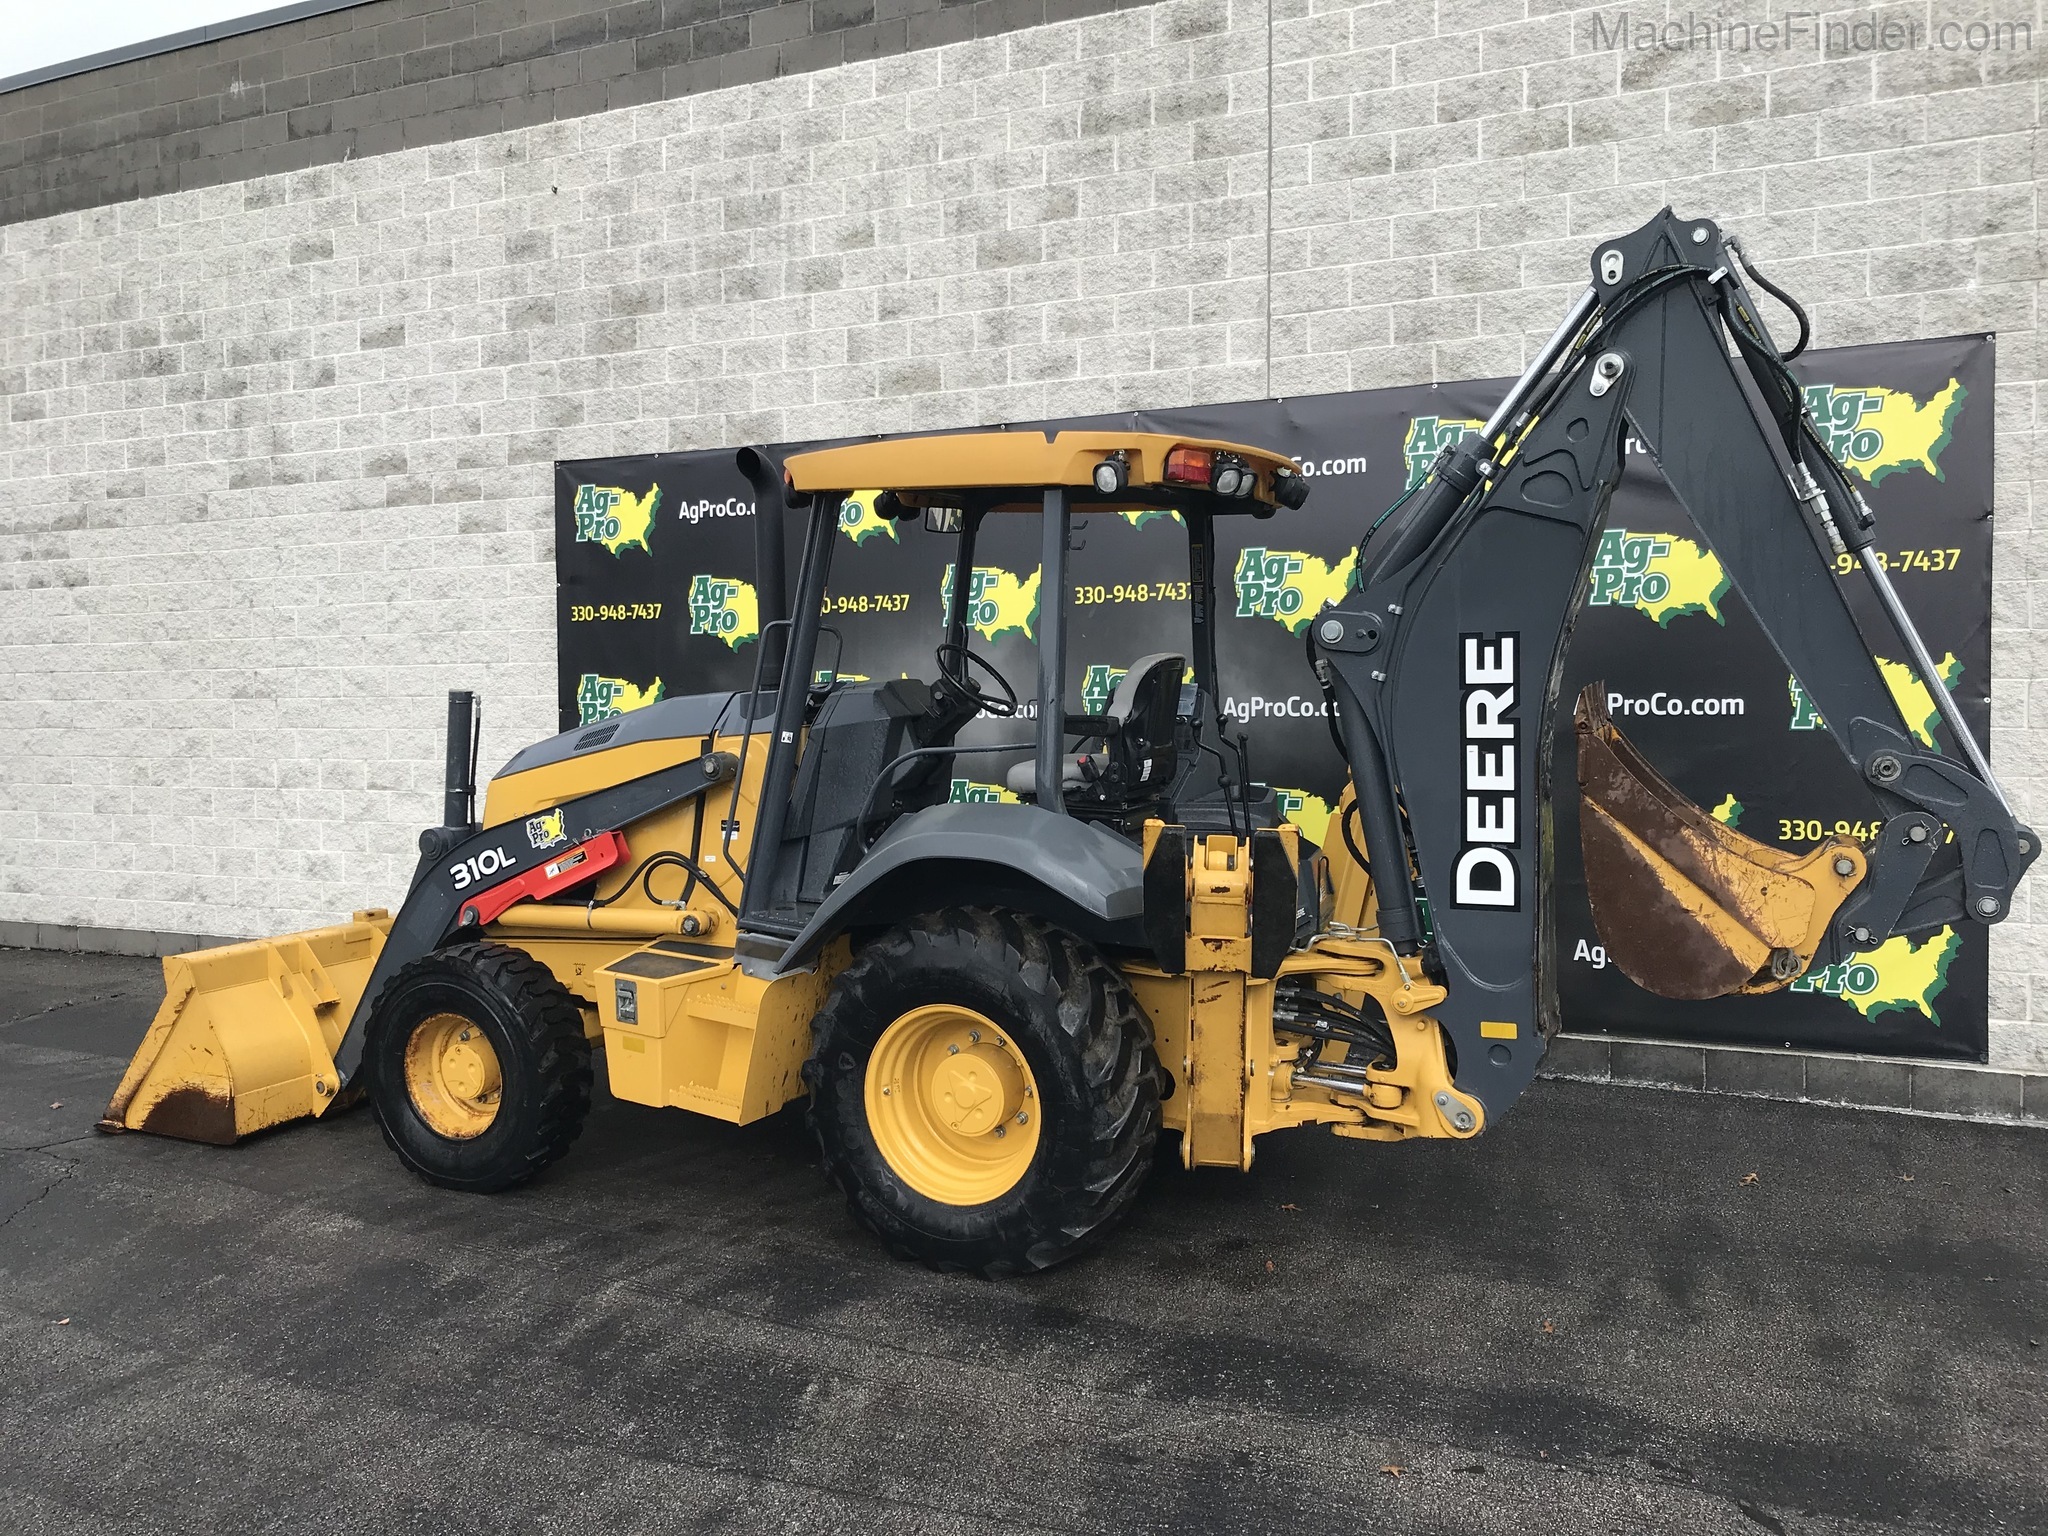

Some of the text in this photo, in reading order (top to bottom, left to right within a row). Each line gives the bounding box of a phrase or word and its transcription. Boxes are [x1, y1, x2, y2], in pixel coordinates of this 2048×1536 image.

[1816, 424, 1883, 463] ro
[575, 483, 620, 519] Ag-
[575, 512, 621, 542] Pro
[1236, 547, 1303, 589] Ag-
[1592, 529, 1670, 575] Ag-
[690, 575, 739, 610] Ag-
[1235, 581, 1303, 617] Pro
[1589, 566, 1670, 605] Pro
[571, 603, 662, 622] 330-948-7437
[690, 605, 739, 635] Pro
[579, 674, 624, 709] Ag-
[1456, 636, 1516, 907] DEERE
[532, 830, 550, 845] Pro
[448, 845, 517, 891] 310L
